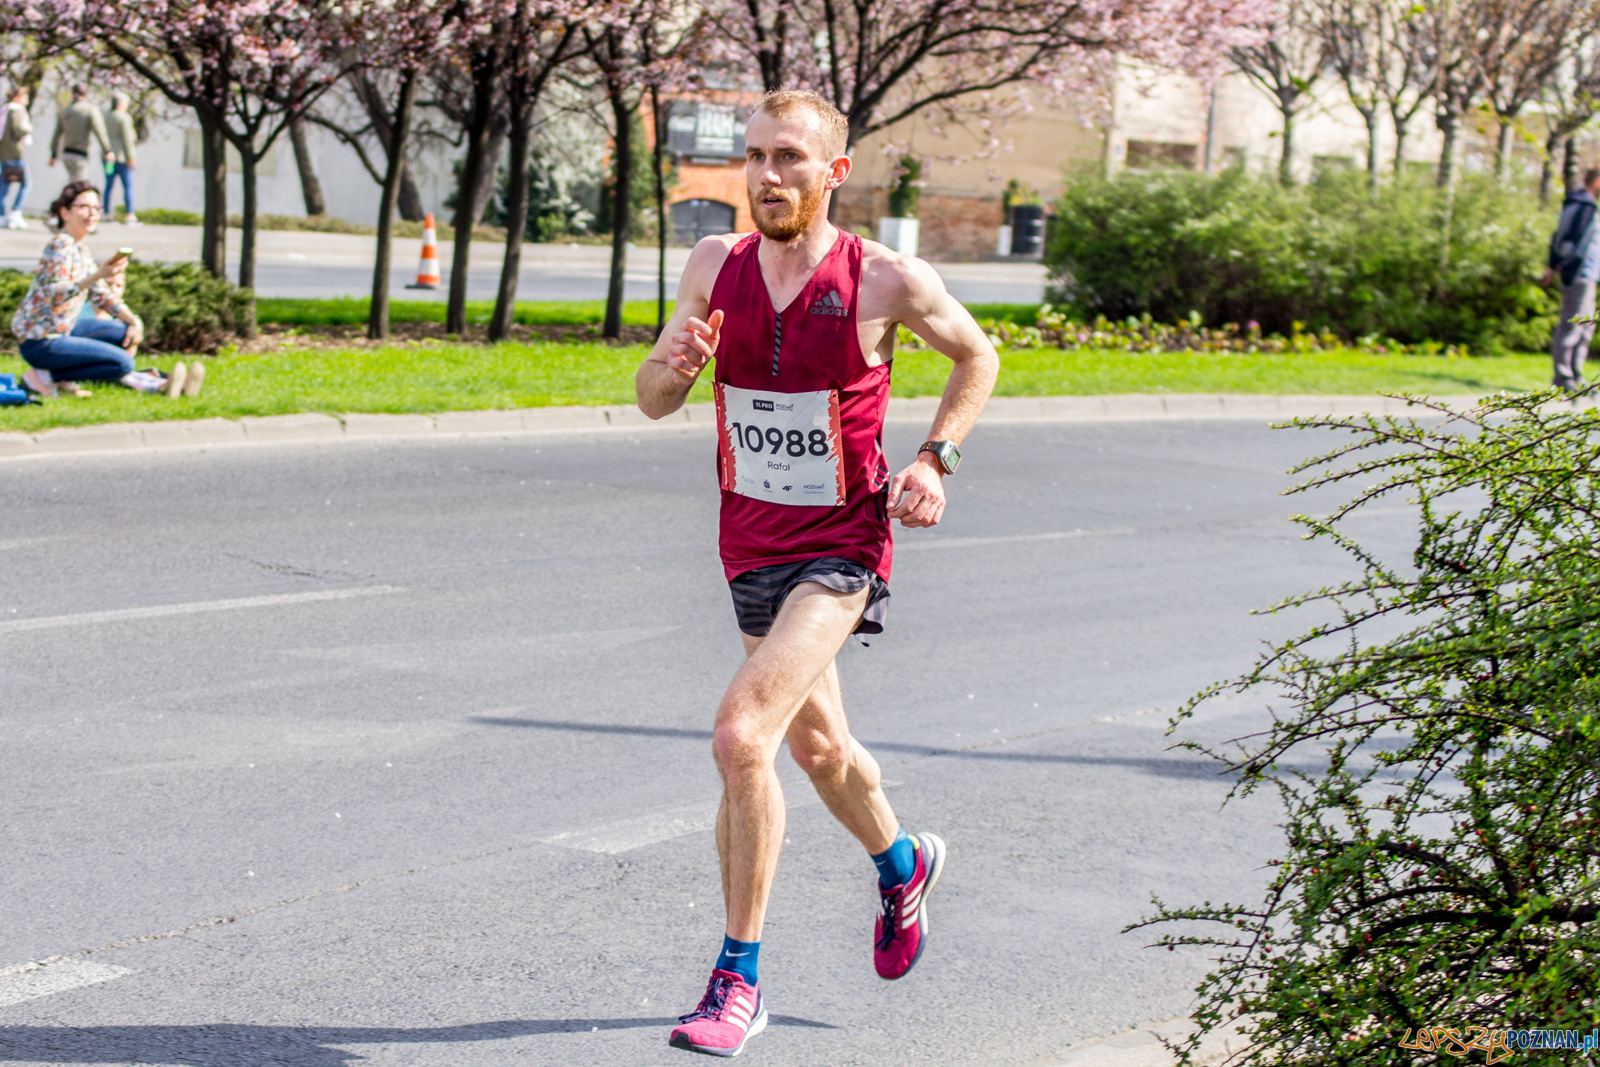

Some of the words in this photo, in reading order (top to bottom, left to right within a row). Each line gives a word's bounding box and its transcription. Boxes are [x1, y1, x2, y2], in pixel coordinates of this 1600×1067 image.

[810, 306, 848, 317] adidas
[732, 422, 829, 457] 10988
[767, 461, 791, 471] Rafał
